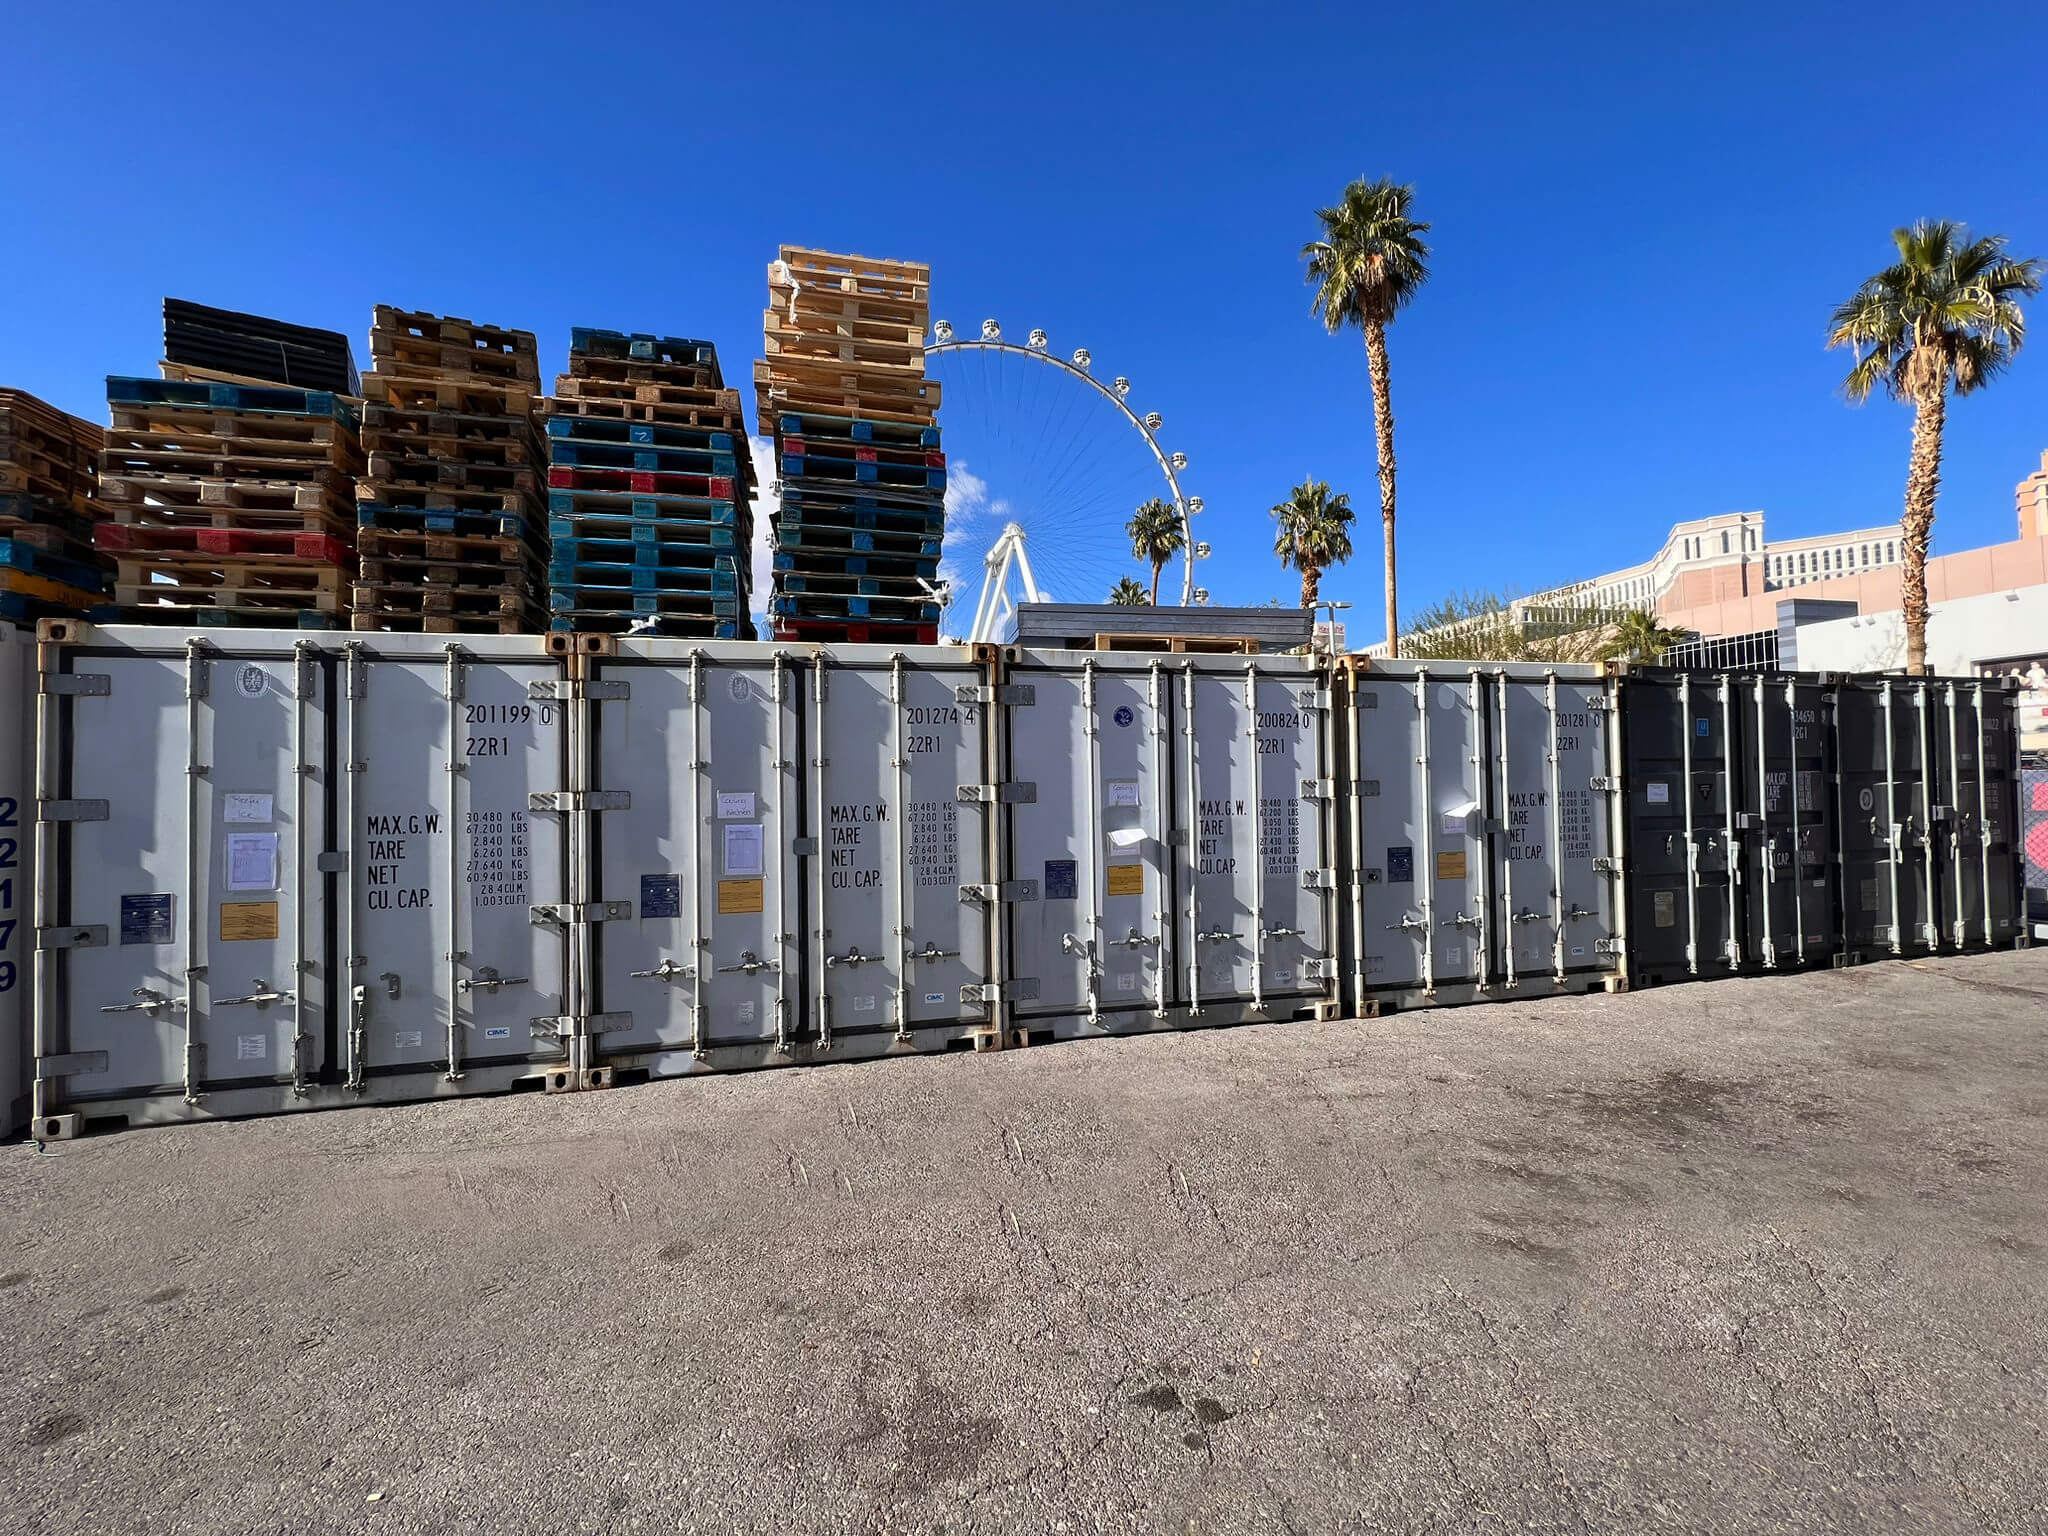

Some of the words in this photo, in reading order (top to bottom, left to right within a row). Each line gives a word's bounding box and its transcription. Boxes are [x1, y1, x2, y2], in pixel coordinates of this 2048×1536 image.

[466, 704, 530, 724] 201199
[541, 705, 551, 724] 0
[907, 707, 958, 725] 201274
[966, 707, 974, 724] 4
[1257, 712, 1299, 728] 200824
[1556, 713, 1588, 728] 201281
[466, 737, 507, 756] 22R1
[907, 736, 940, 753] 22R1
[1257, 738, 1285, 754] 22R1
[1556, 736, 1579, 751] 22R1
[943, 801, 952, 811] KG
[466, 812, 502, 823] 30.480
[511, 812, 522, 821] KG
[943, 812, 957, 821] LBS
[1509, 810, 1529, 825] TARE
[466, 823, 502, 834] 67.200
[511, 823, 528, 833] LBS
[943, 823, 953, 832] KG
[1199, 820, 1224, 835] TARE
[1509, 828, 1526, 842] NET
[473, 836, 502, 847] 2.840
[511, 835, 522, 845] KG
[831, 826, 861, 845] TARE
[944, 833, 957, 842] LBS
[367, 840, 406, 860] TARE
[473, 847, 503, 858] 6.260
[511, 847, 528, 857] LBS
[944, 845, 953, 853] KG
[1199, 839, 1217, 855] NET
[466, 860, 503, 871] 27.640
[511, 859, 523, 869] KG
[831, 849, 855, 867] NET
[944, 855, 958, 864] LBS
[367, 865, 399, 885] NET
[466, 871, 503, 883] 60.940
[512, 871, 528, 881] LBS
[397, 888, 433, 908] CAP.
